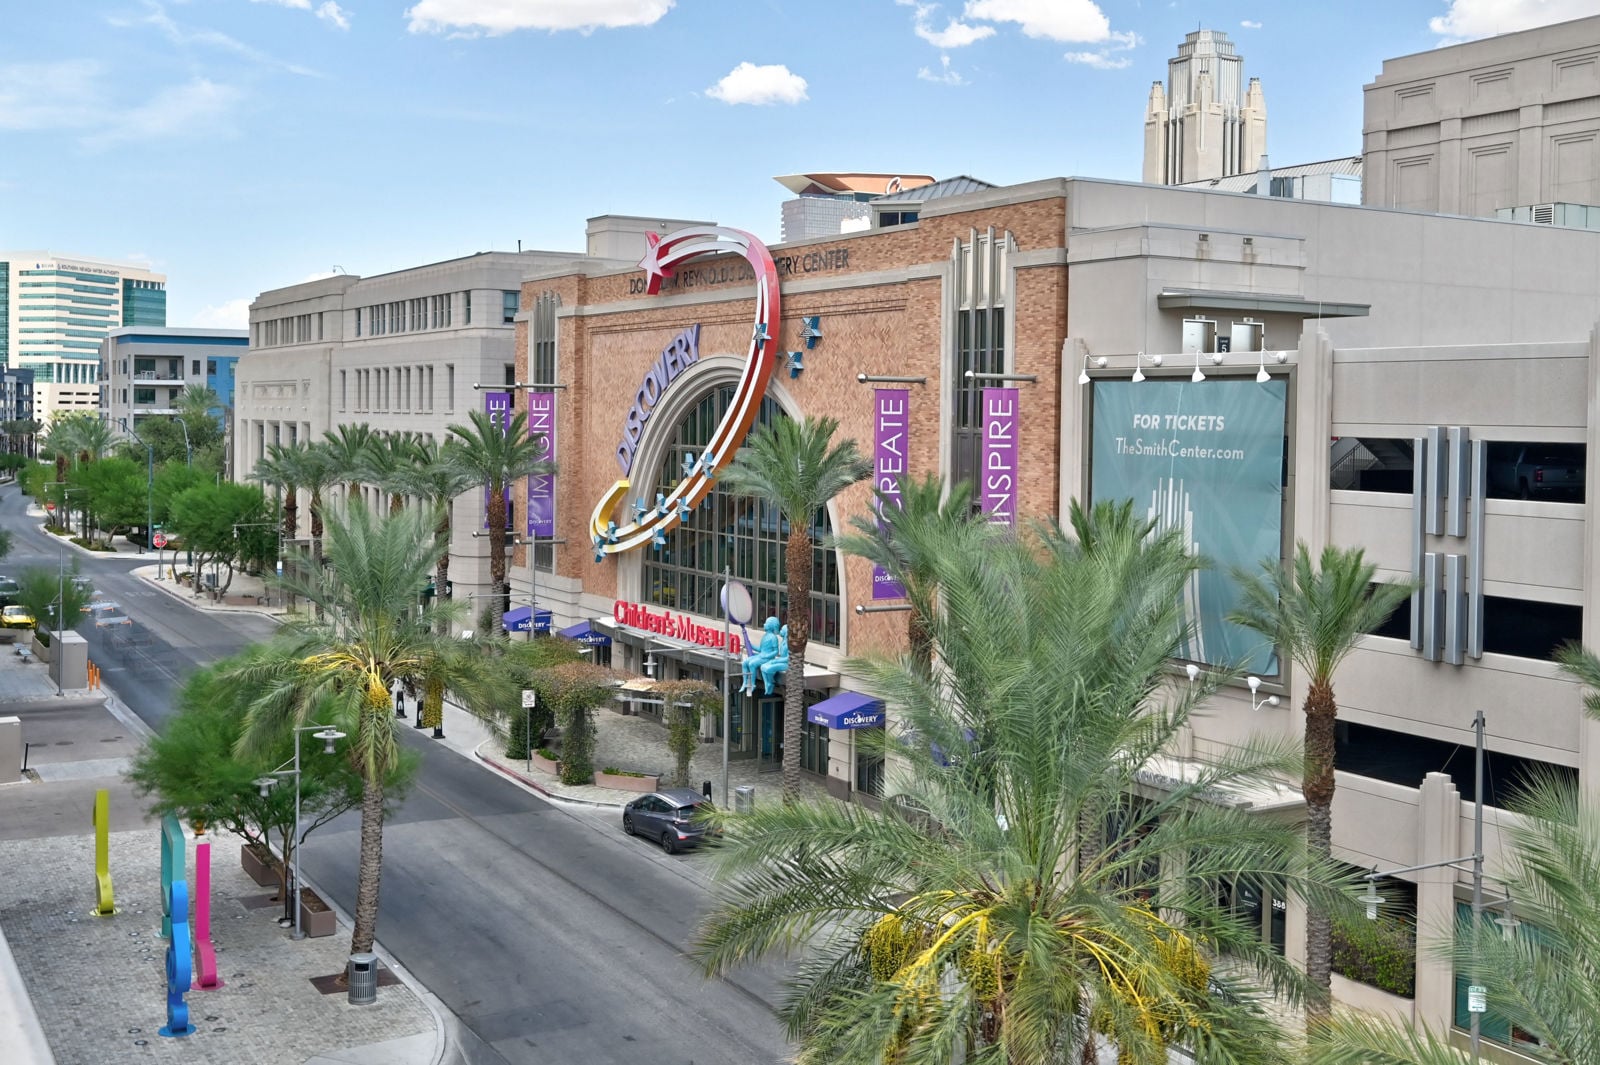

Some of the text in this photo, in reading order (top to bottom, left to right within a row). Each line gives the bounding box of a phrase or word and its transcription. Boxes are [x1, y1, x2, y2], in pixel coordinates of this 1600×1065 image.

[683, 266, 735, 288] REYNOLDS
[802, 249, 850, 273] CENTER
[616, 323, 701, 477] DISCOVERY
[1133, 414, 1225, 431] FOR TICKETS
[879, 399, 903, 523] CREATE
[988, 399, 1013, 525] INSPIRE
[1115, 437, 1244, 460] TheSmithCenter.com
[613, 600, 676, 637] Children's
[843, 714, 878, 725] DISCOVERY
